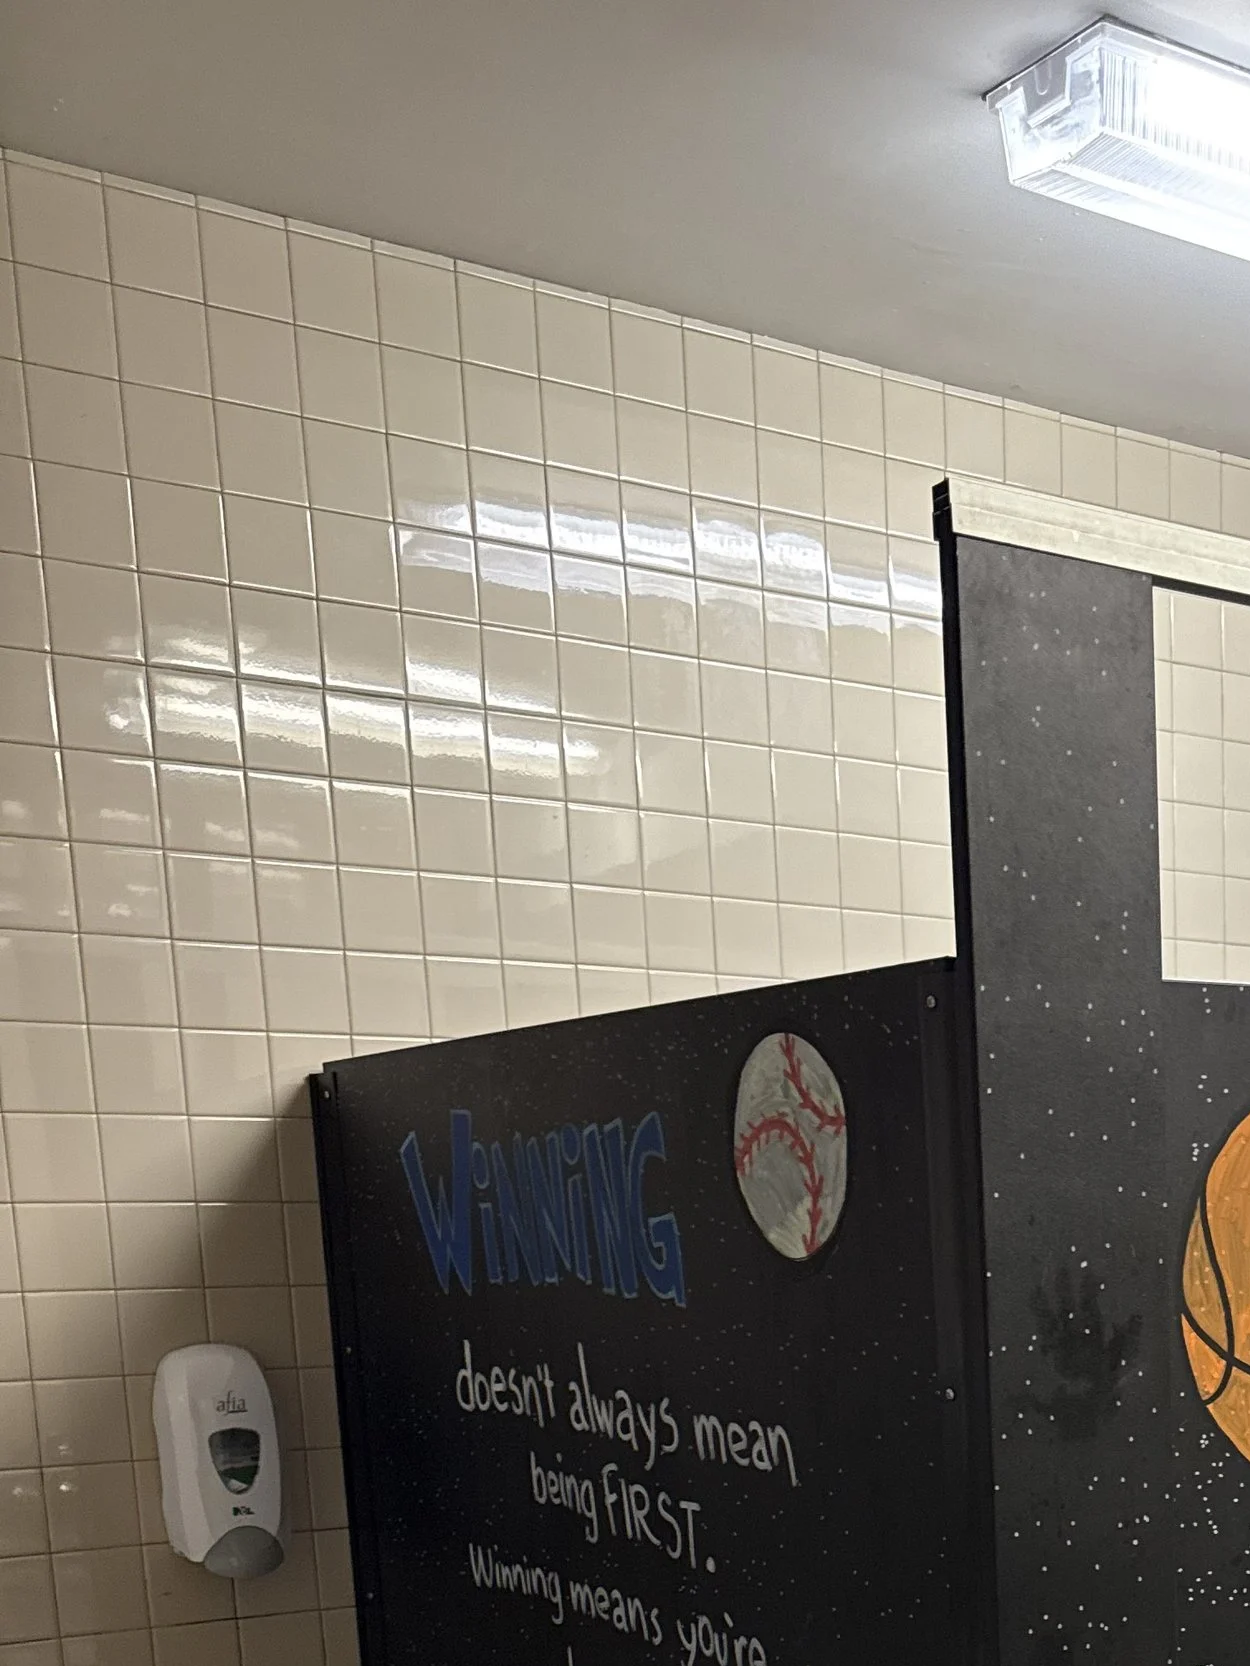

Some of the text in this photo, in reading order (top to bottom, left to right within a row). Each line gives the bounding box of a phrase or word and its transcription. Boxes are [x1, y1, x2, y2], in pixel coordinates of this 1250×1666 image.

[456, 1339, 798, 1488] doesn't always mean
[530, 1450, 599, 1544] being
[469, 1543, 564, 1625] Winning
[570, 1580, 663, 1646] means
